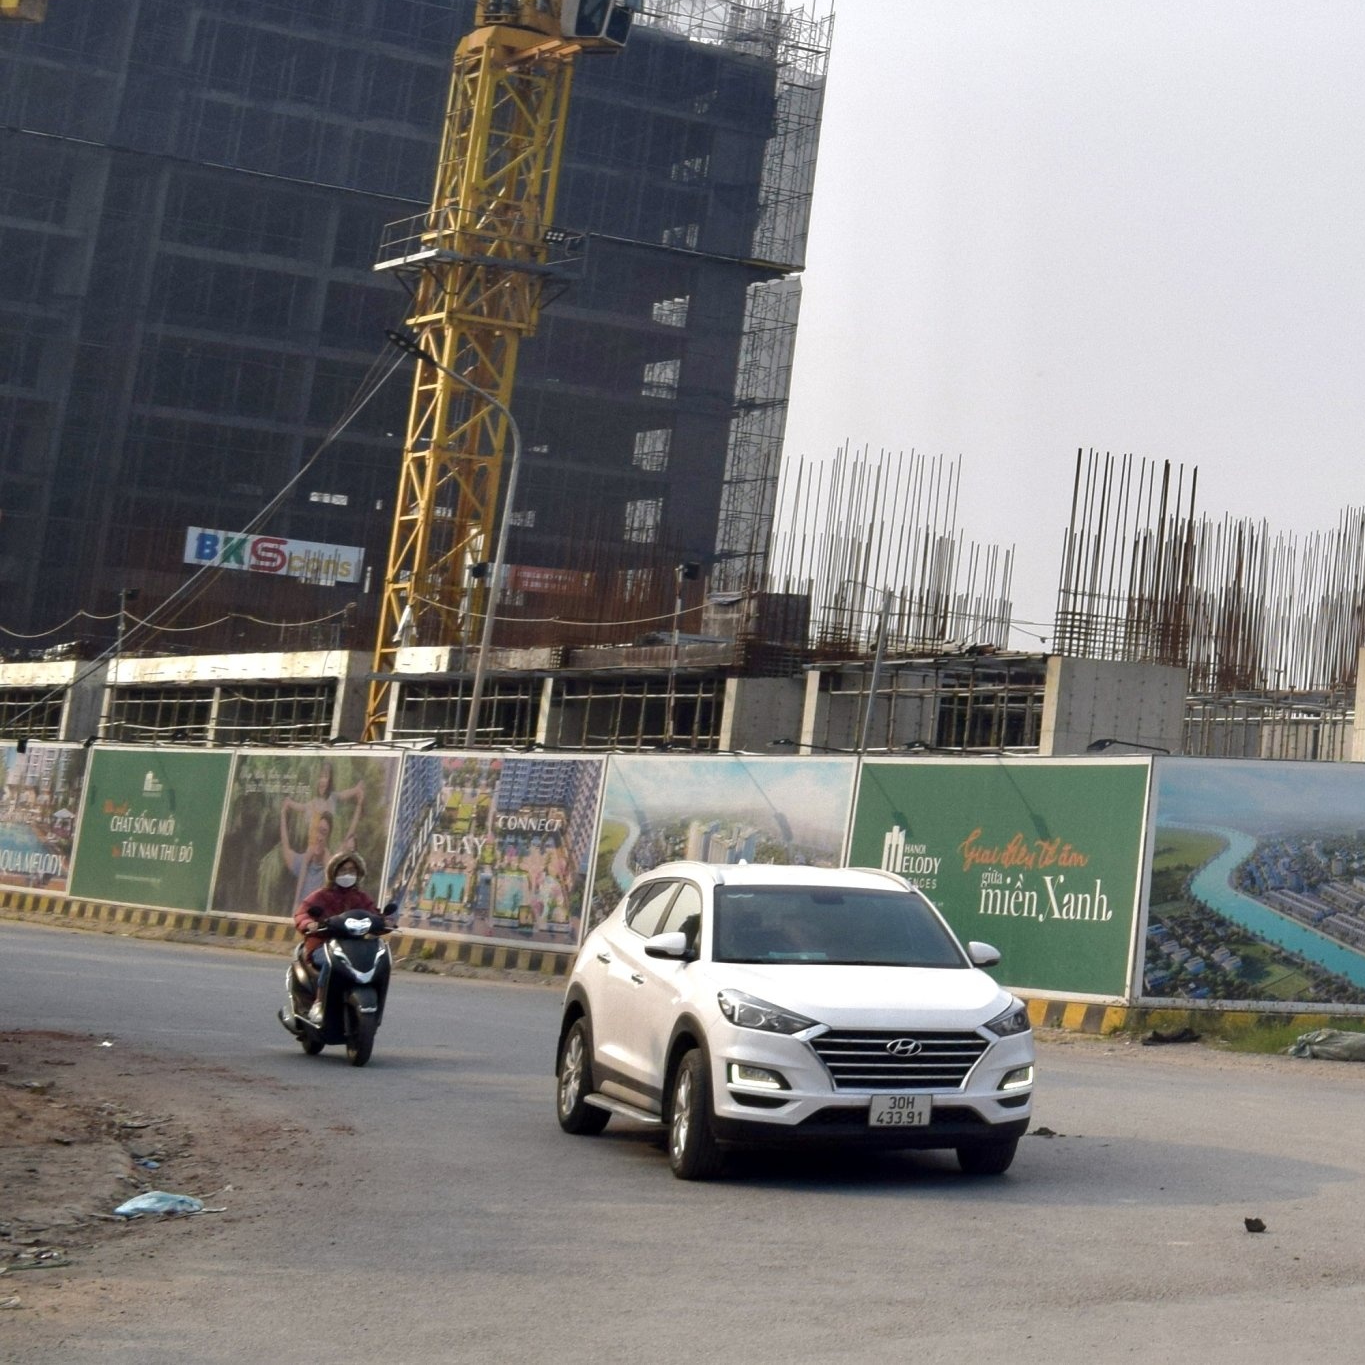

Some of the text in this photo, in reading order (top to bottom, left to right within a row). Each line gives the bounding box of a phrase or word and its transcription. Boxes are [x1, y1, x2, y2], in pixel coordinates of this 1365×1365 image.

[498, 815, 562, 833] CONNECT
[432, 833, 487, 856] PLAY
[905, 844, 927, 854] HANOI
[979, 873, 1112, 922] miền Xanh
[889, 1096, 915, 1110] 30H
[876, 1111, 922, 1125] 433.91
